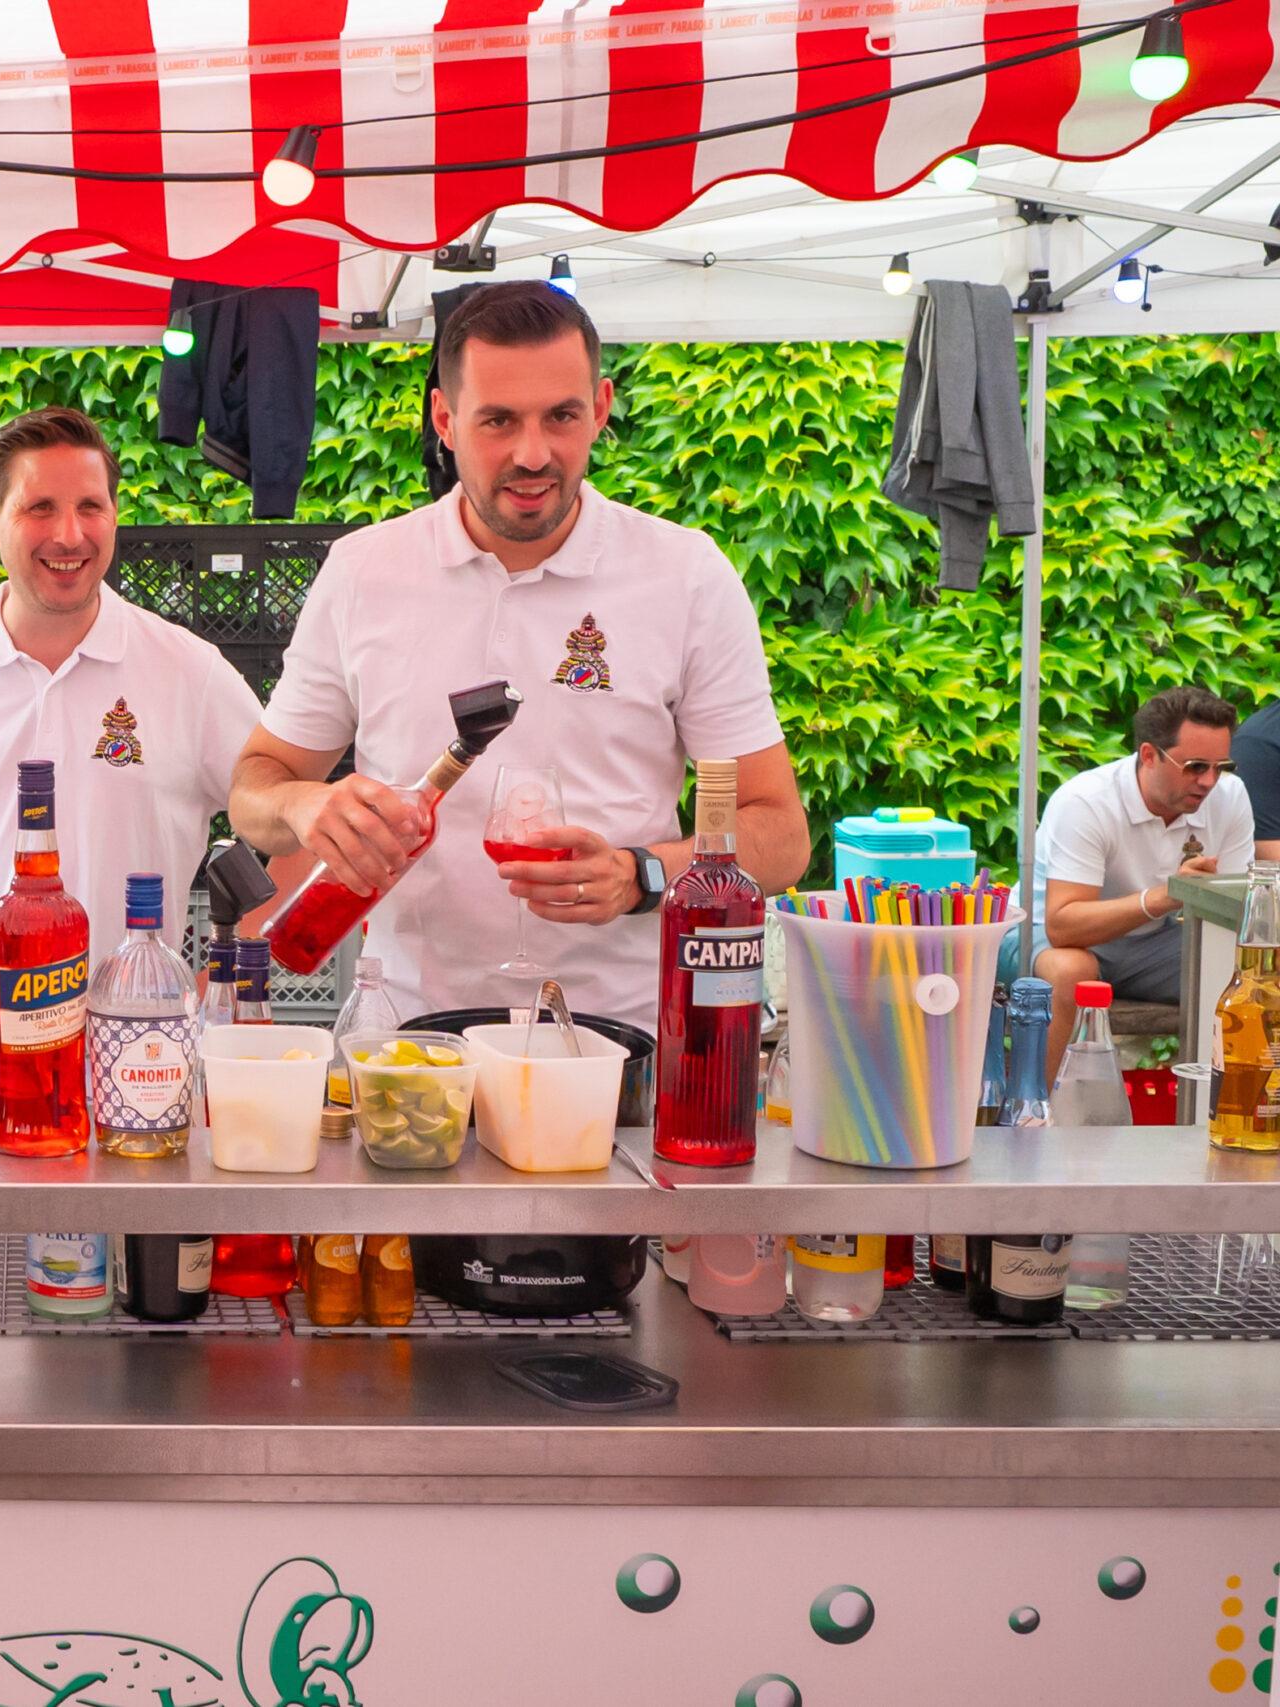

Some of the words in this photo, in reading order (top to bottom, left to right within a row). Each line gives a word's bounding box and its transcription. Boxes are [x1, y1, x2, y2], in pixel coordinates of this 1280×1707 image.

[626, 22, 664, 37] LAMBERT
[670, 19, 714, 33] PARASOLS
[19, 1006, 67, 1022] APERITIVO
[120, 1067, 182, 1083] CANONITA
[499, 1274, 586, 1286] TROJKAVODKA.COM
